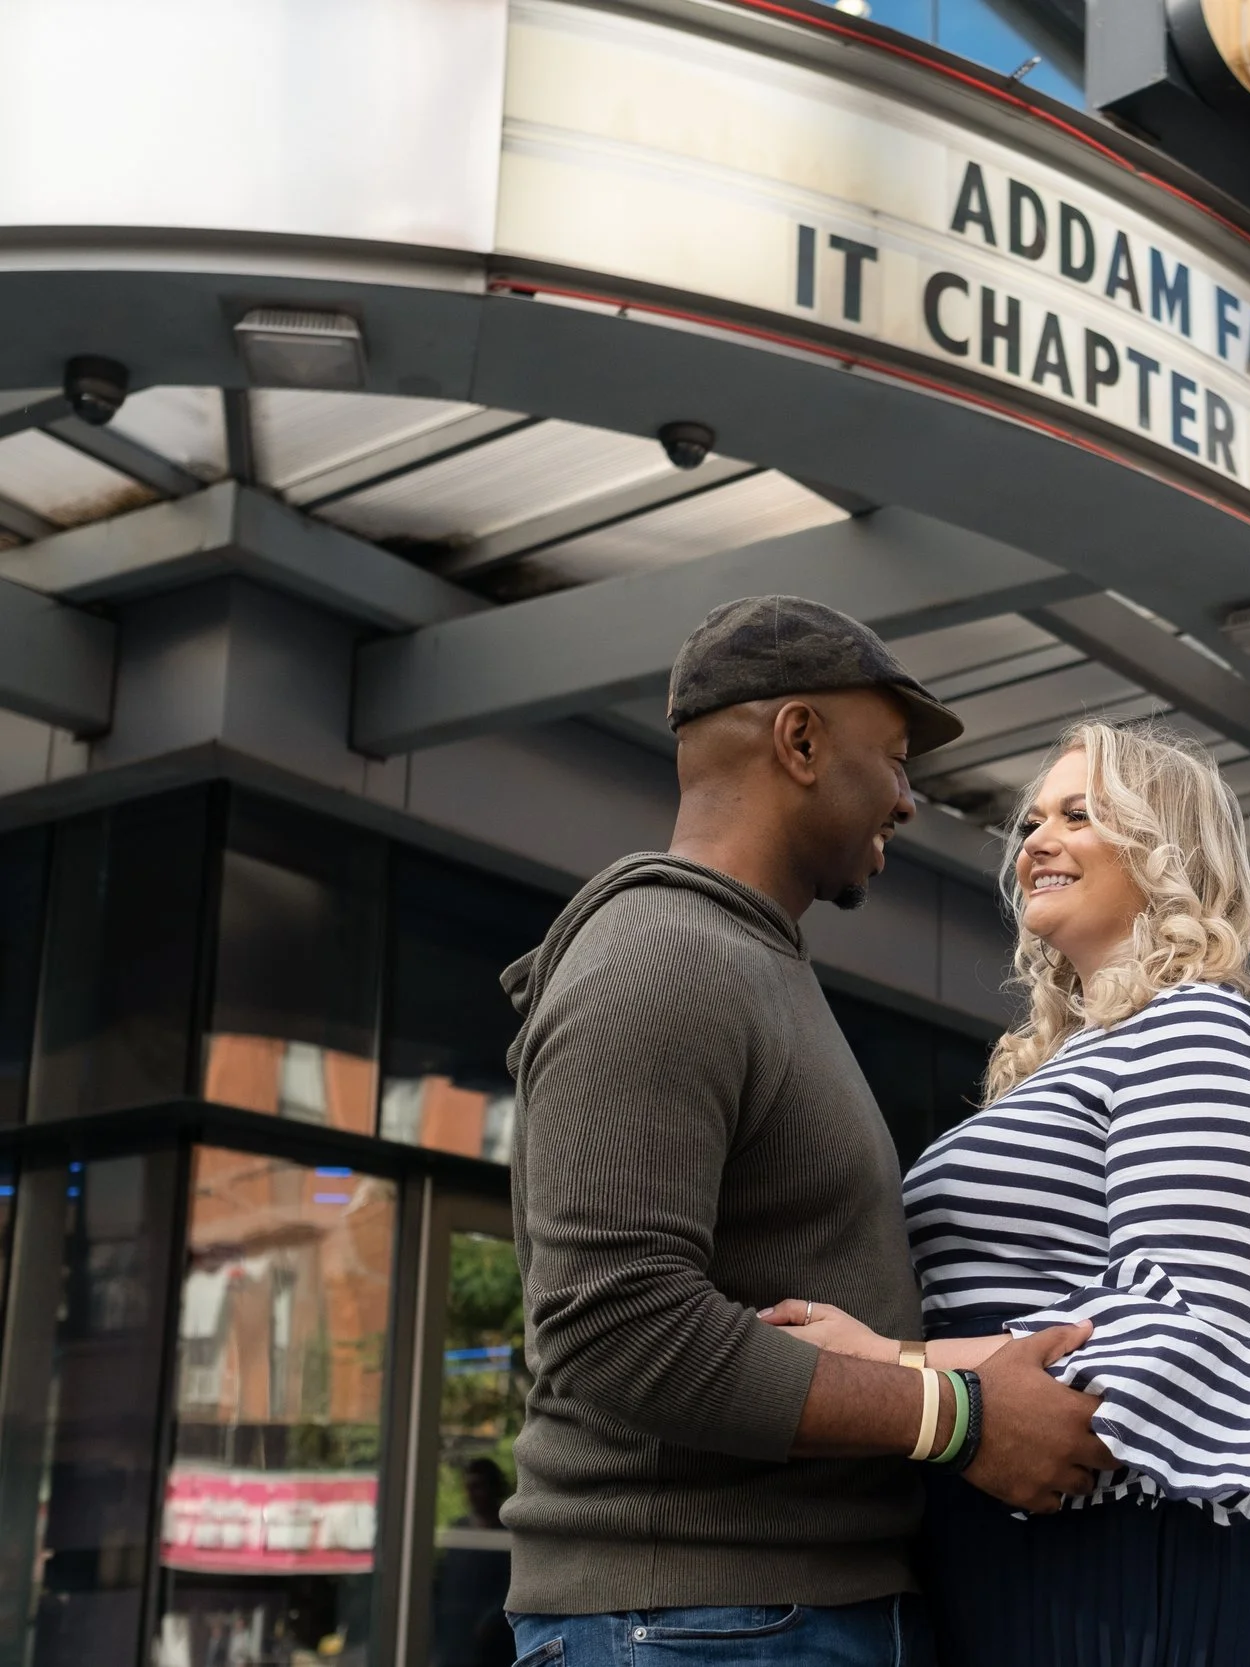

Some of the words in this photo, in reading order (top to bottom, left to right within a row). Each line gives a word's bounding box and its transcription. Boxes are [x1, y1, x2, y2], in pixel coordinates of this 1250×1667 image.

[795, 223, 877, 323] IT
[923, 270, 1237, 476] CHAPTER
[949, 160, 1191, 337] ADDAM
